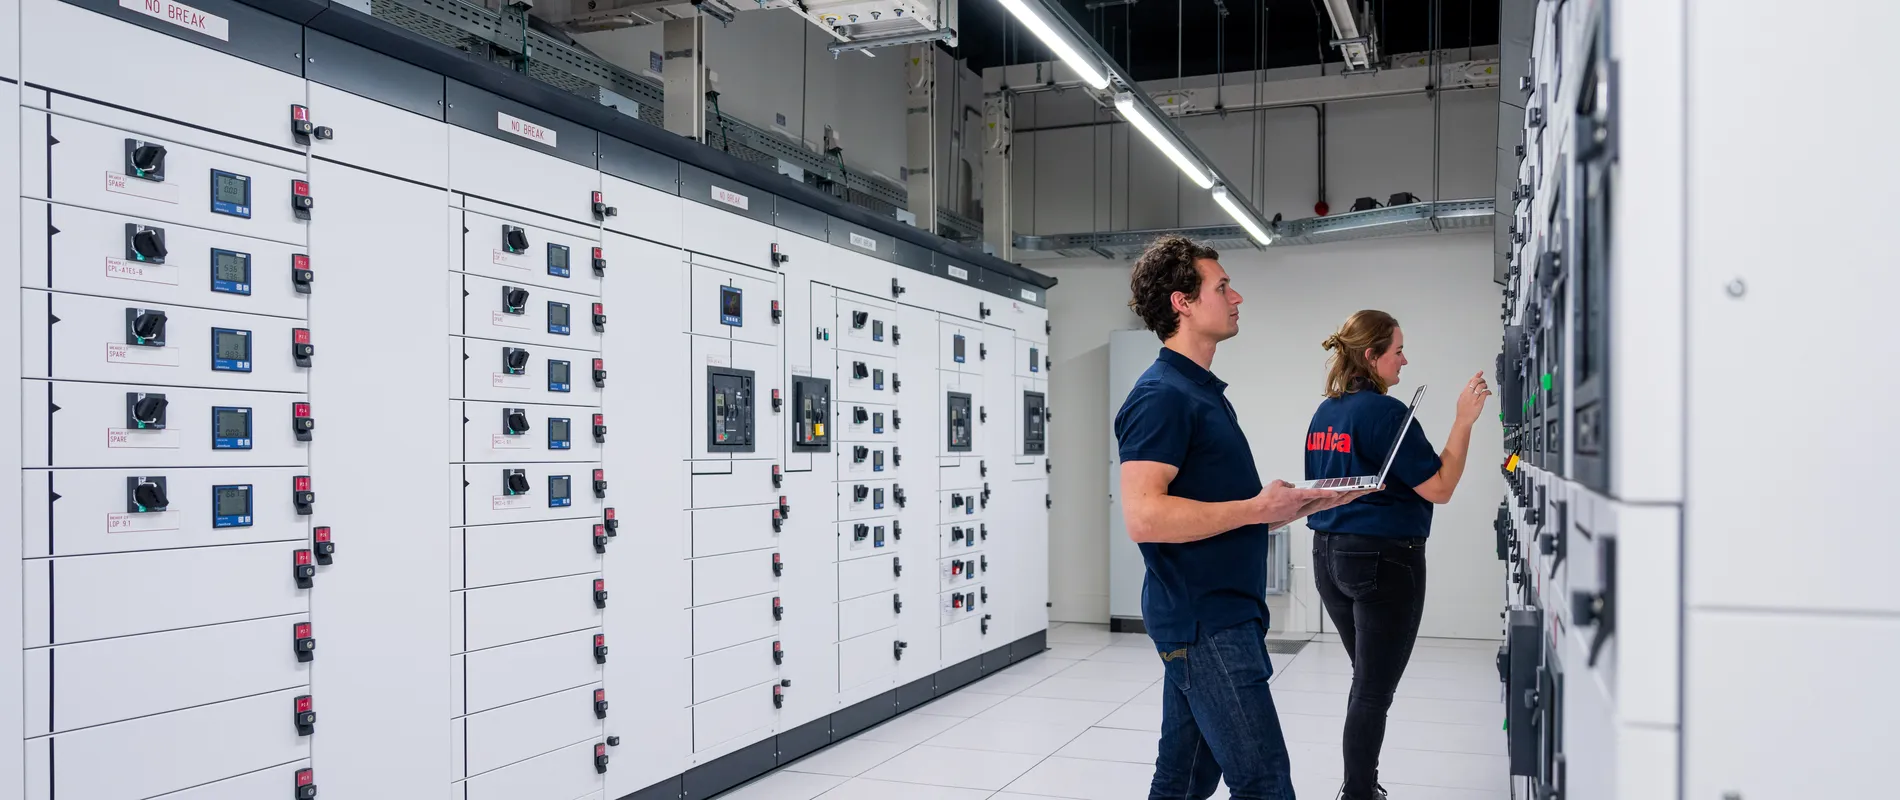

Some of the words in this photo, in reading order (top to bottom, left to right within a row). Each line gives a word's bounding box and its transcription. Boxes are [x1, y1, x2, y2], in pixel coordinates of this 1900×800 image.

[145, 0, 160, 13] NO
[168, 4, 206, 29] BREAK
[511, 120, 520, 132] NO
[523, 124, 545, 140] BREAK
[108, 180, 125, 189] SPARE
[109, 350, 126, 358] SPARE
[1307, 426, 1351, 453] unica
